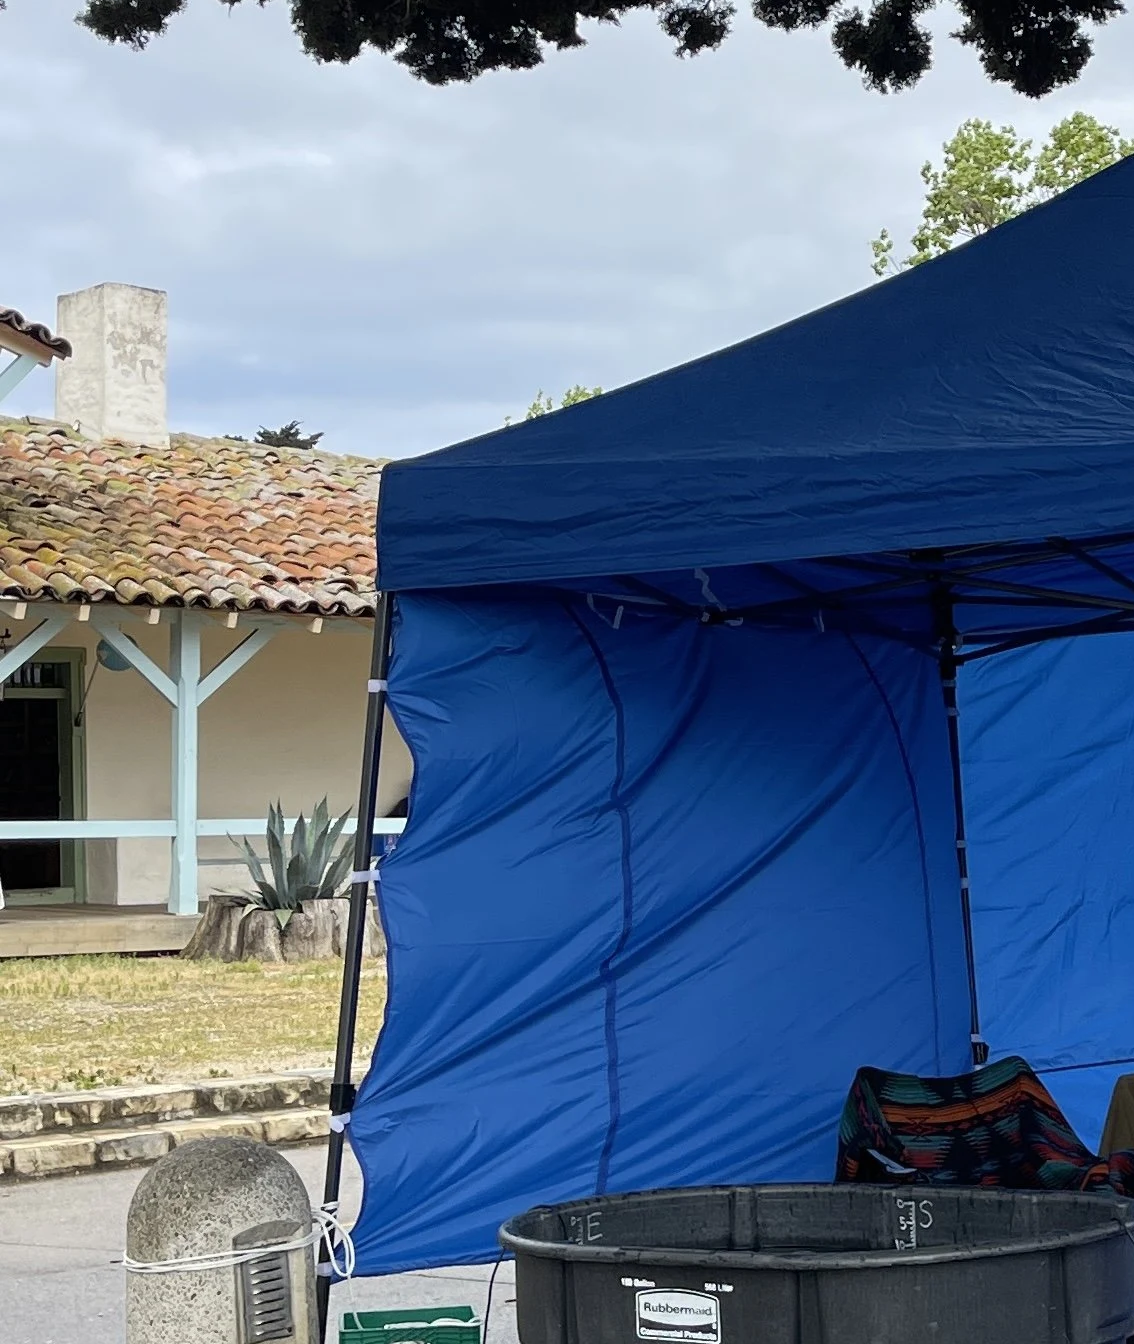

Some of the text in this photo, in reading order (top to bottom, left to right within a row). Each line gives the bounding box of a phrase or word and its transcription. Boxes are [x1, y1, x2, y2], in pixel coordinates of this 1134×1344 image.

[586, 1211, 604, 1241] E
[919, 1199, 933, 1229] S
[643, 1301, 713, 1316] Rubbermaid
